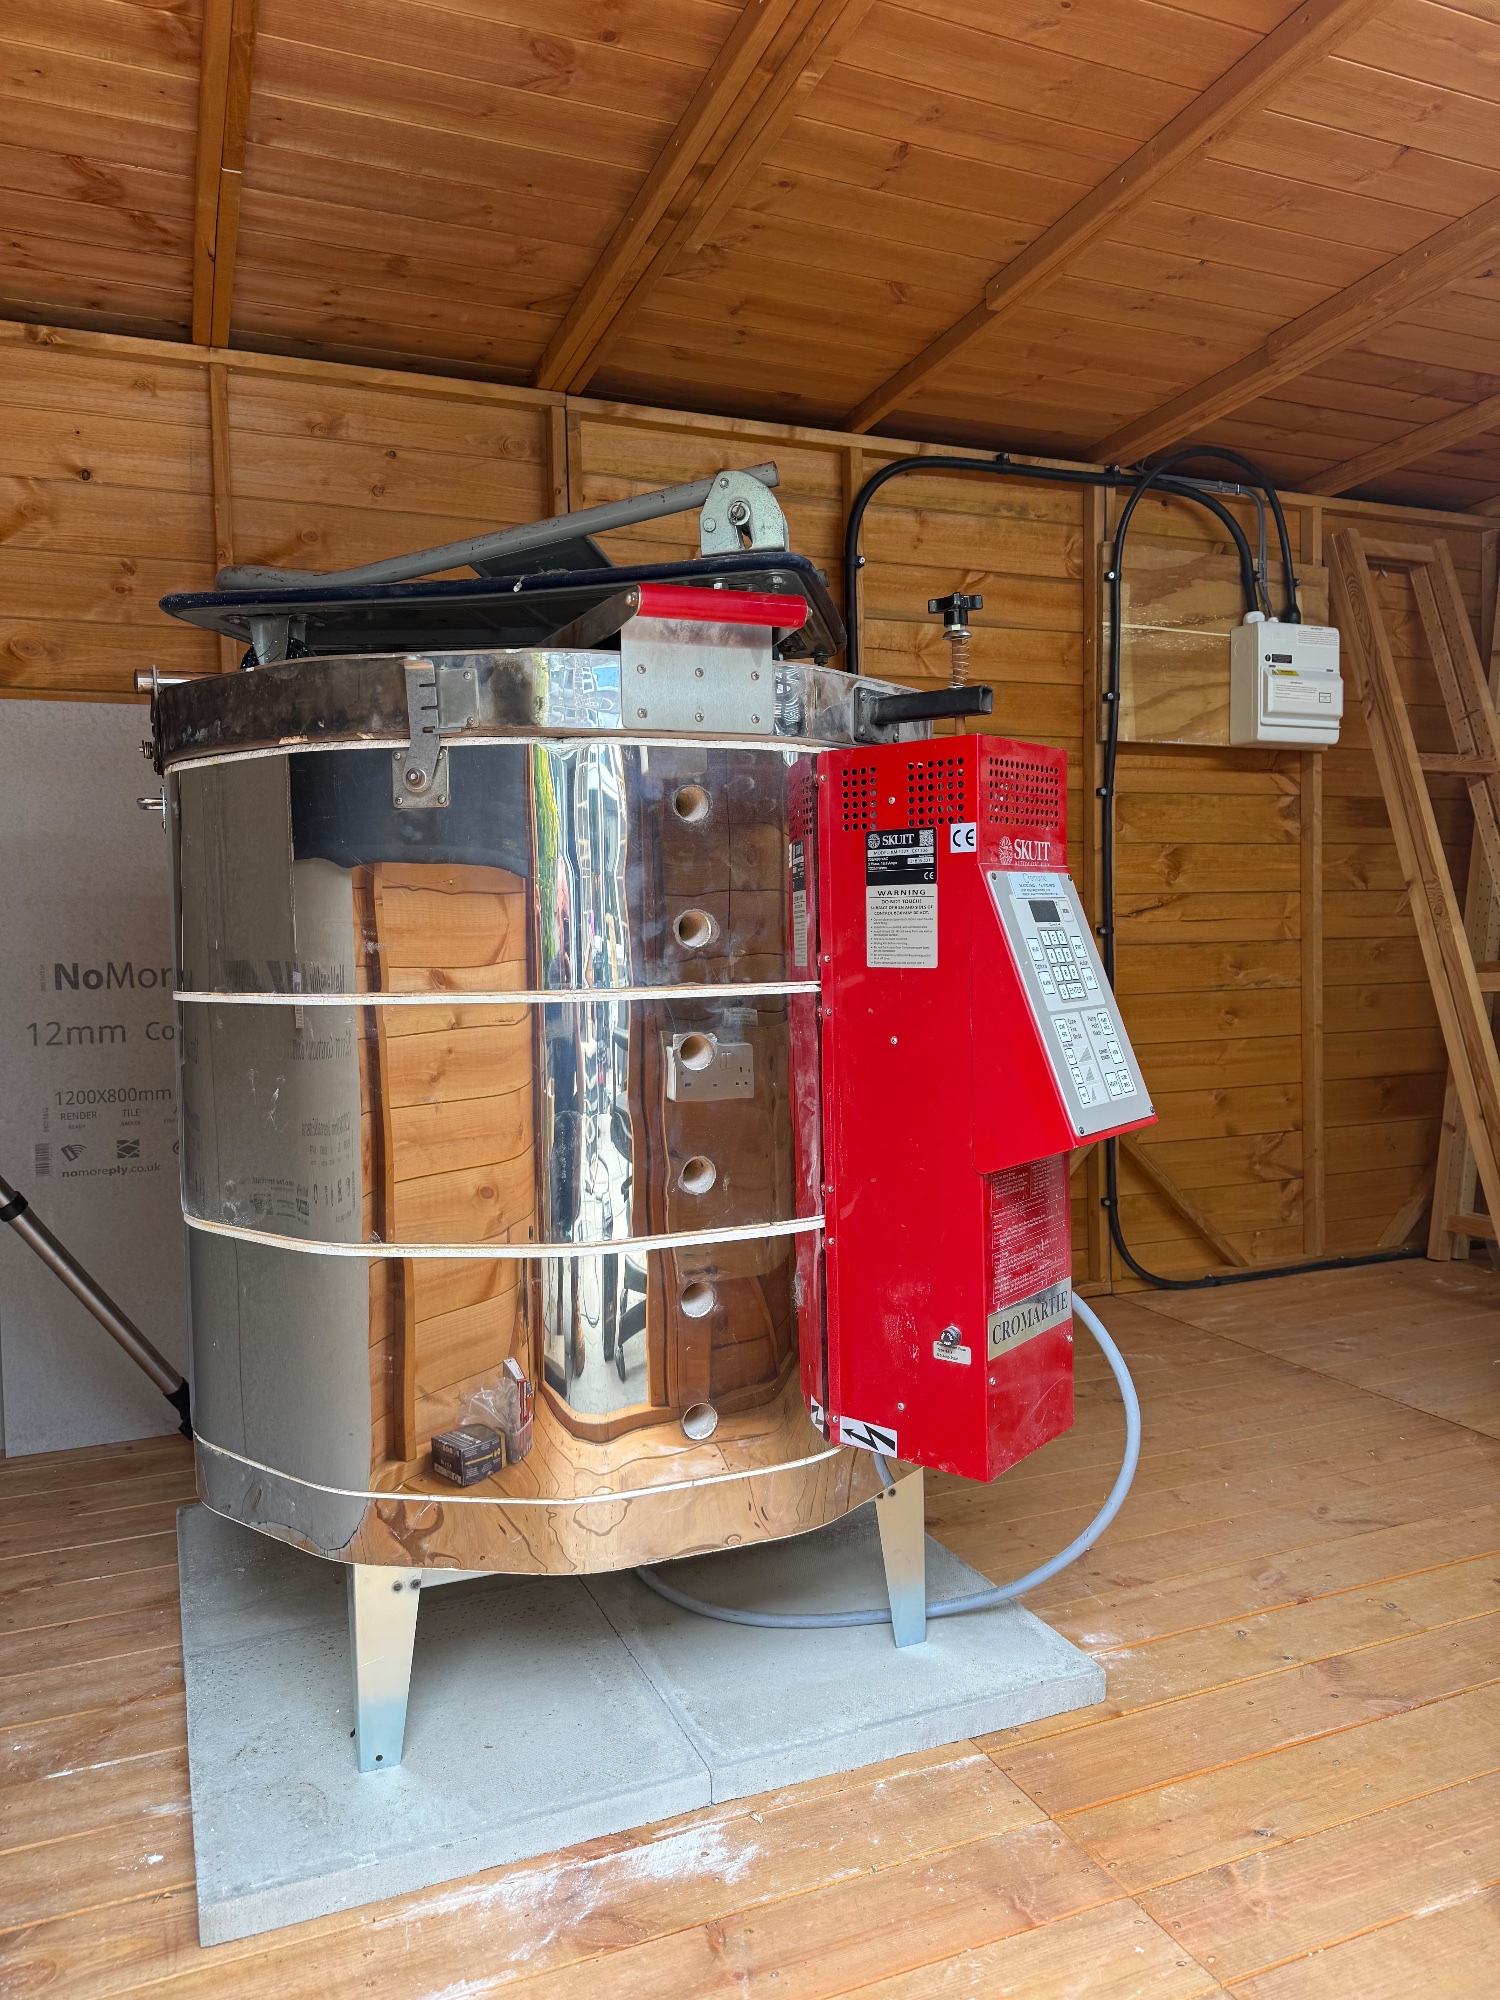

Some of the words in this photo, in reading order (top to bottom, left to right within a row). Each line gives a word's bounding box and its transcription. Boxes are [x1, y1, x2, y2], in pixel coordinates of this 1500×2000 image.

[882, 833, 914, 845] SKUTT
[953, 828, 975, 848] CE
[1013, 838, 1051, 861] SKUTT
[923, 871, 935, 880] CE
[27, 1021, 126, 1046] 12mm
[55, 1087, 172, 1106] 1200X800mm
[60, 1110, 98, 1121] RENDER
[121, 1108, 141, 1117] TILE
[62, 1162, 161, 1178] nomoreply.co.uk
[992, 1290, 1068, 1345] CROMARTIE
